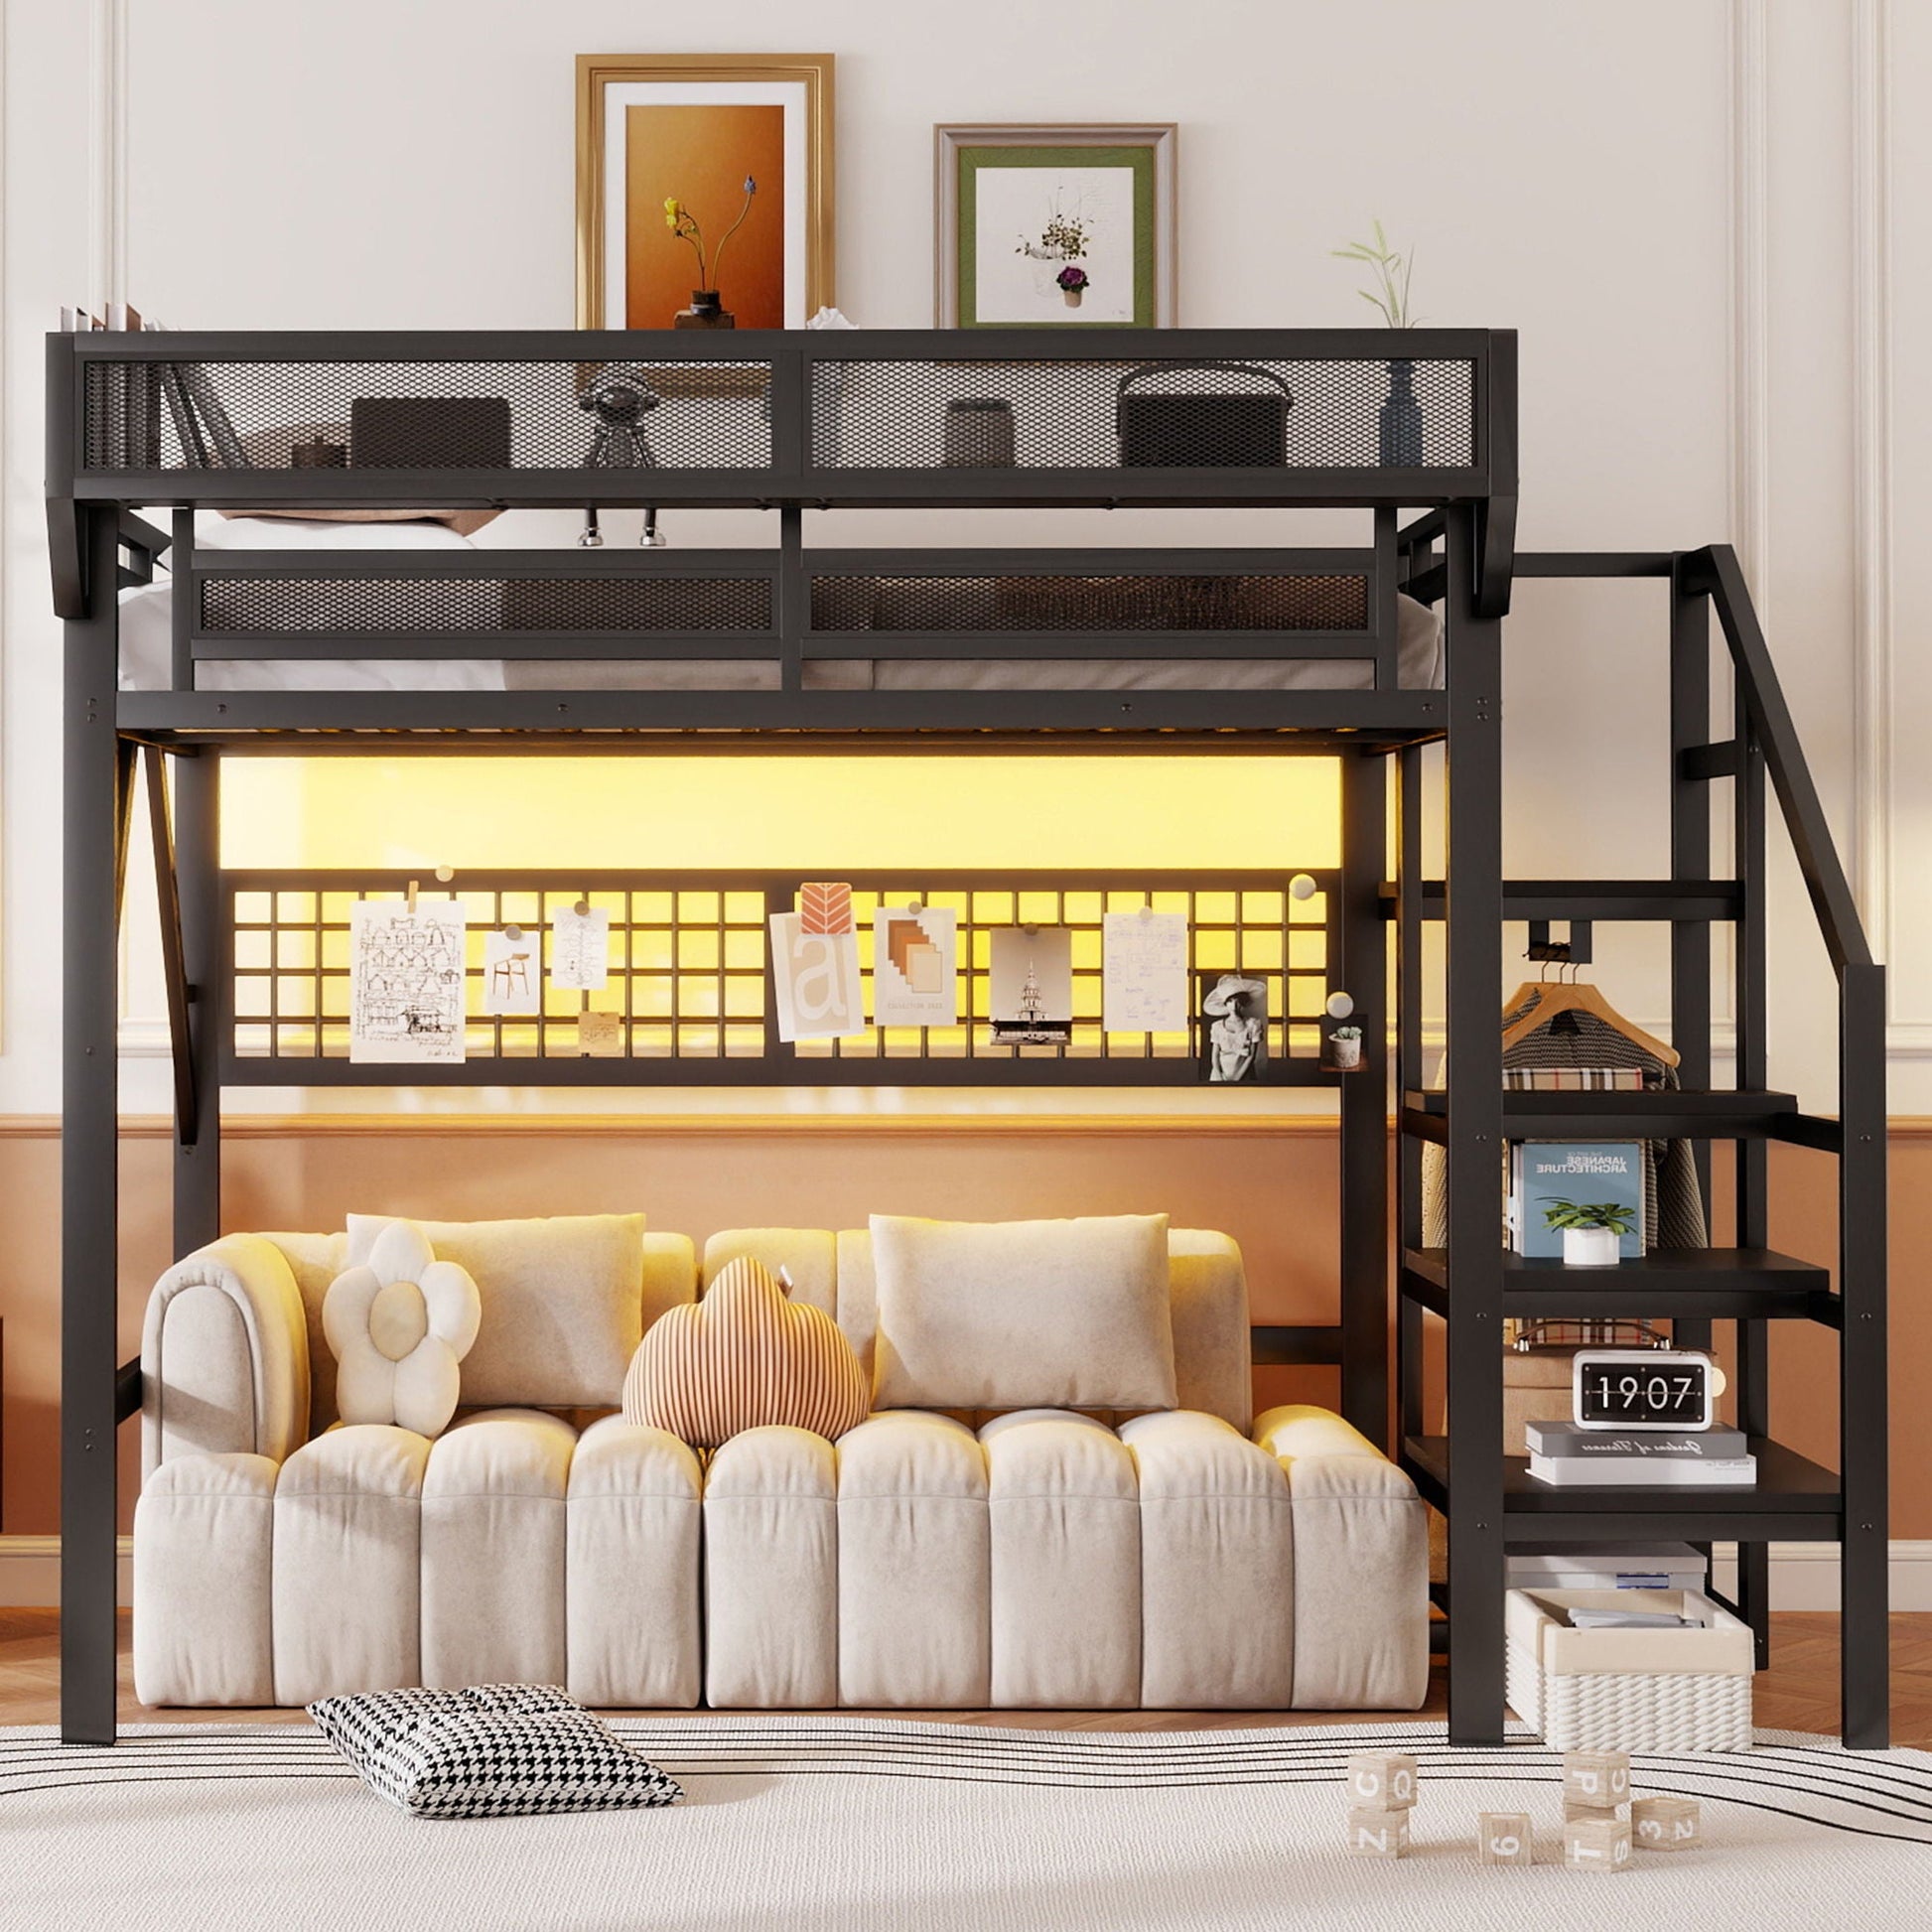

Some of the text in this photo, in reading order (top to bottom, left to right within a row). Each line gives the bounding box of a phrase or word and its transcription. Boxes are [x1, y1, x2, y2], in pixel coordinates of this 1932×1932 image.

[794, 933, 848, 1021] a
[1394, 1769, 1412, 1800] Q
[1573, 1840, 1601, 1863] T
